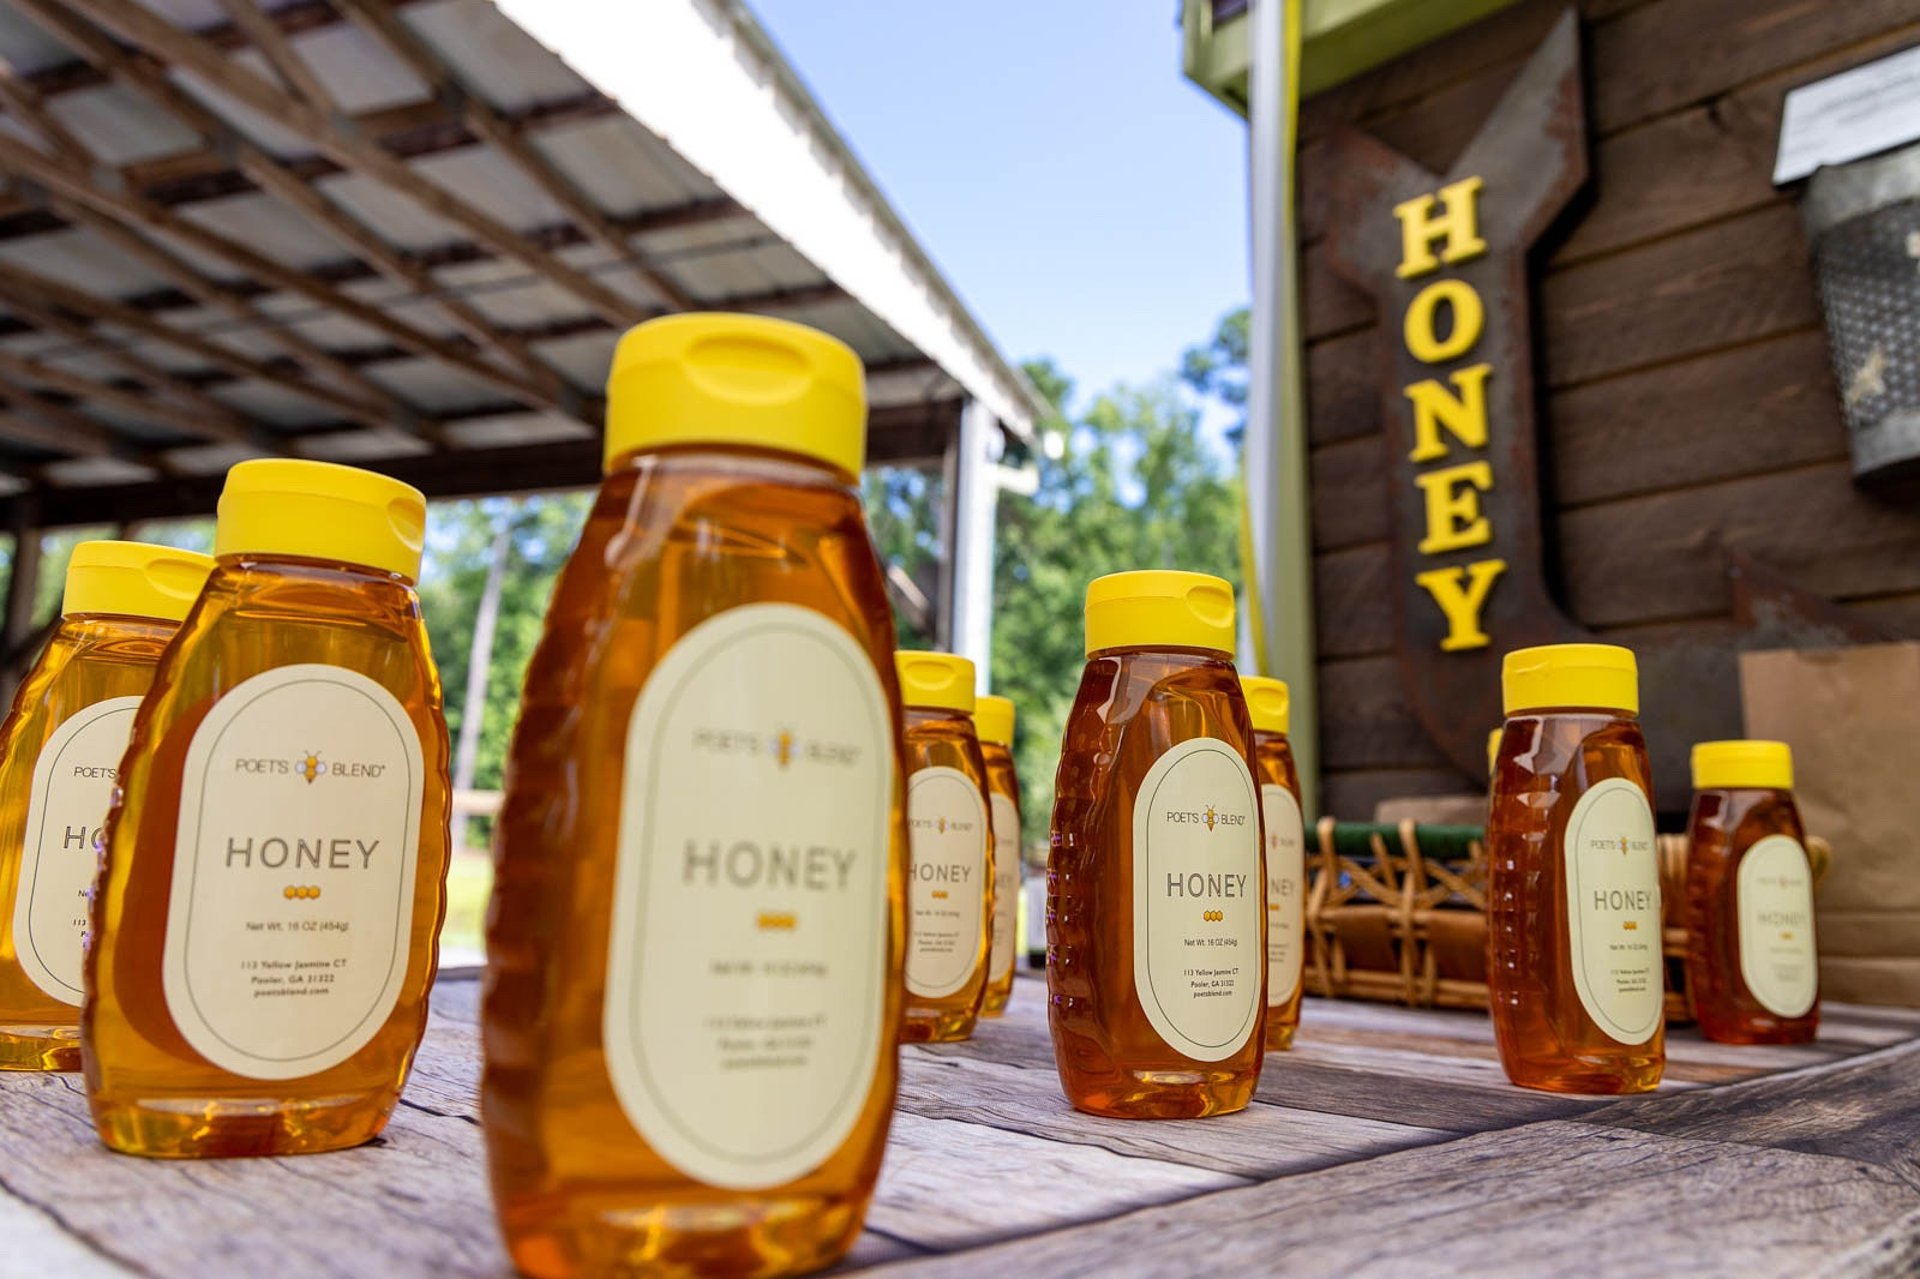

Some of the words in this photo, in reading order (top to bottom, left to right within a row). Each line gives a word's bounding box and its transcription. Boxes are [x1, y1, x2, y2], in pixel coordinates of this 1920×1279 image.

[1393, 175, 1507, 653] HONEY
[235, 758, 289, 774] POET'S
[1166, 811, 1199, 824] POET'S
[226, 837, 380, 869] HONEY
[681, 839, 858, 892] HONEY
[1167, 872, 1247, 898] HONEY
[1594, 890, 1652, 911] HONEY
